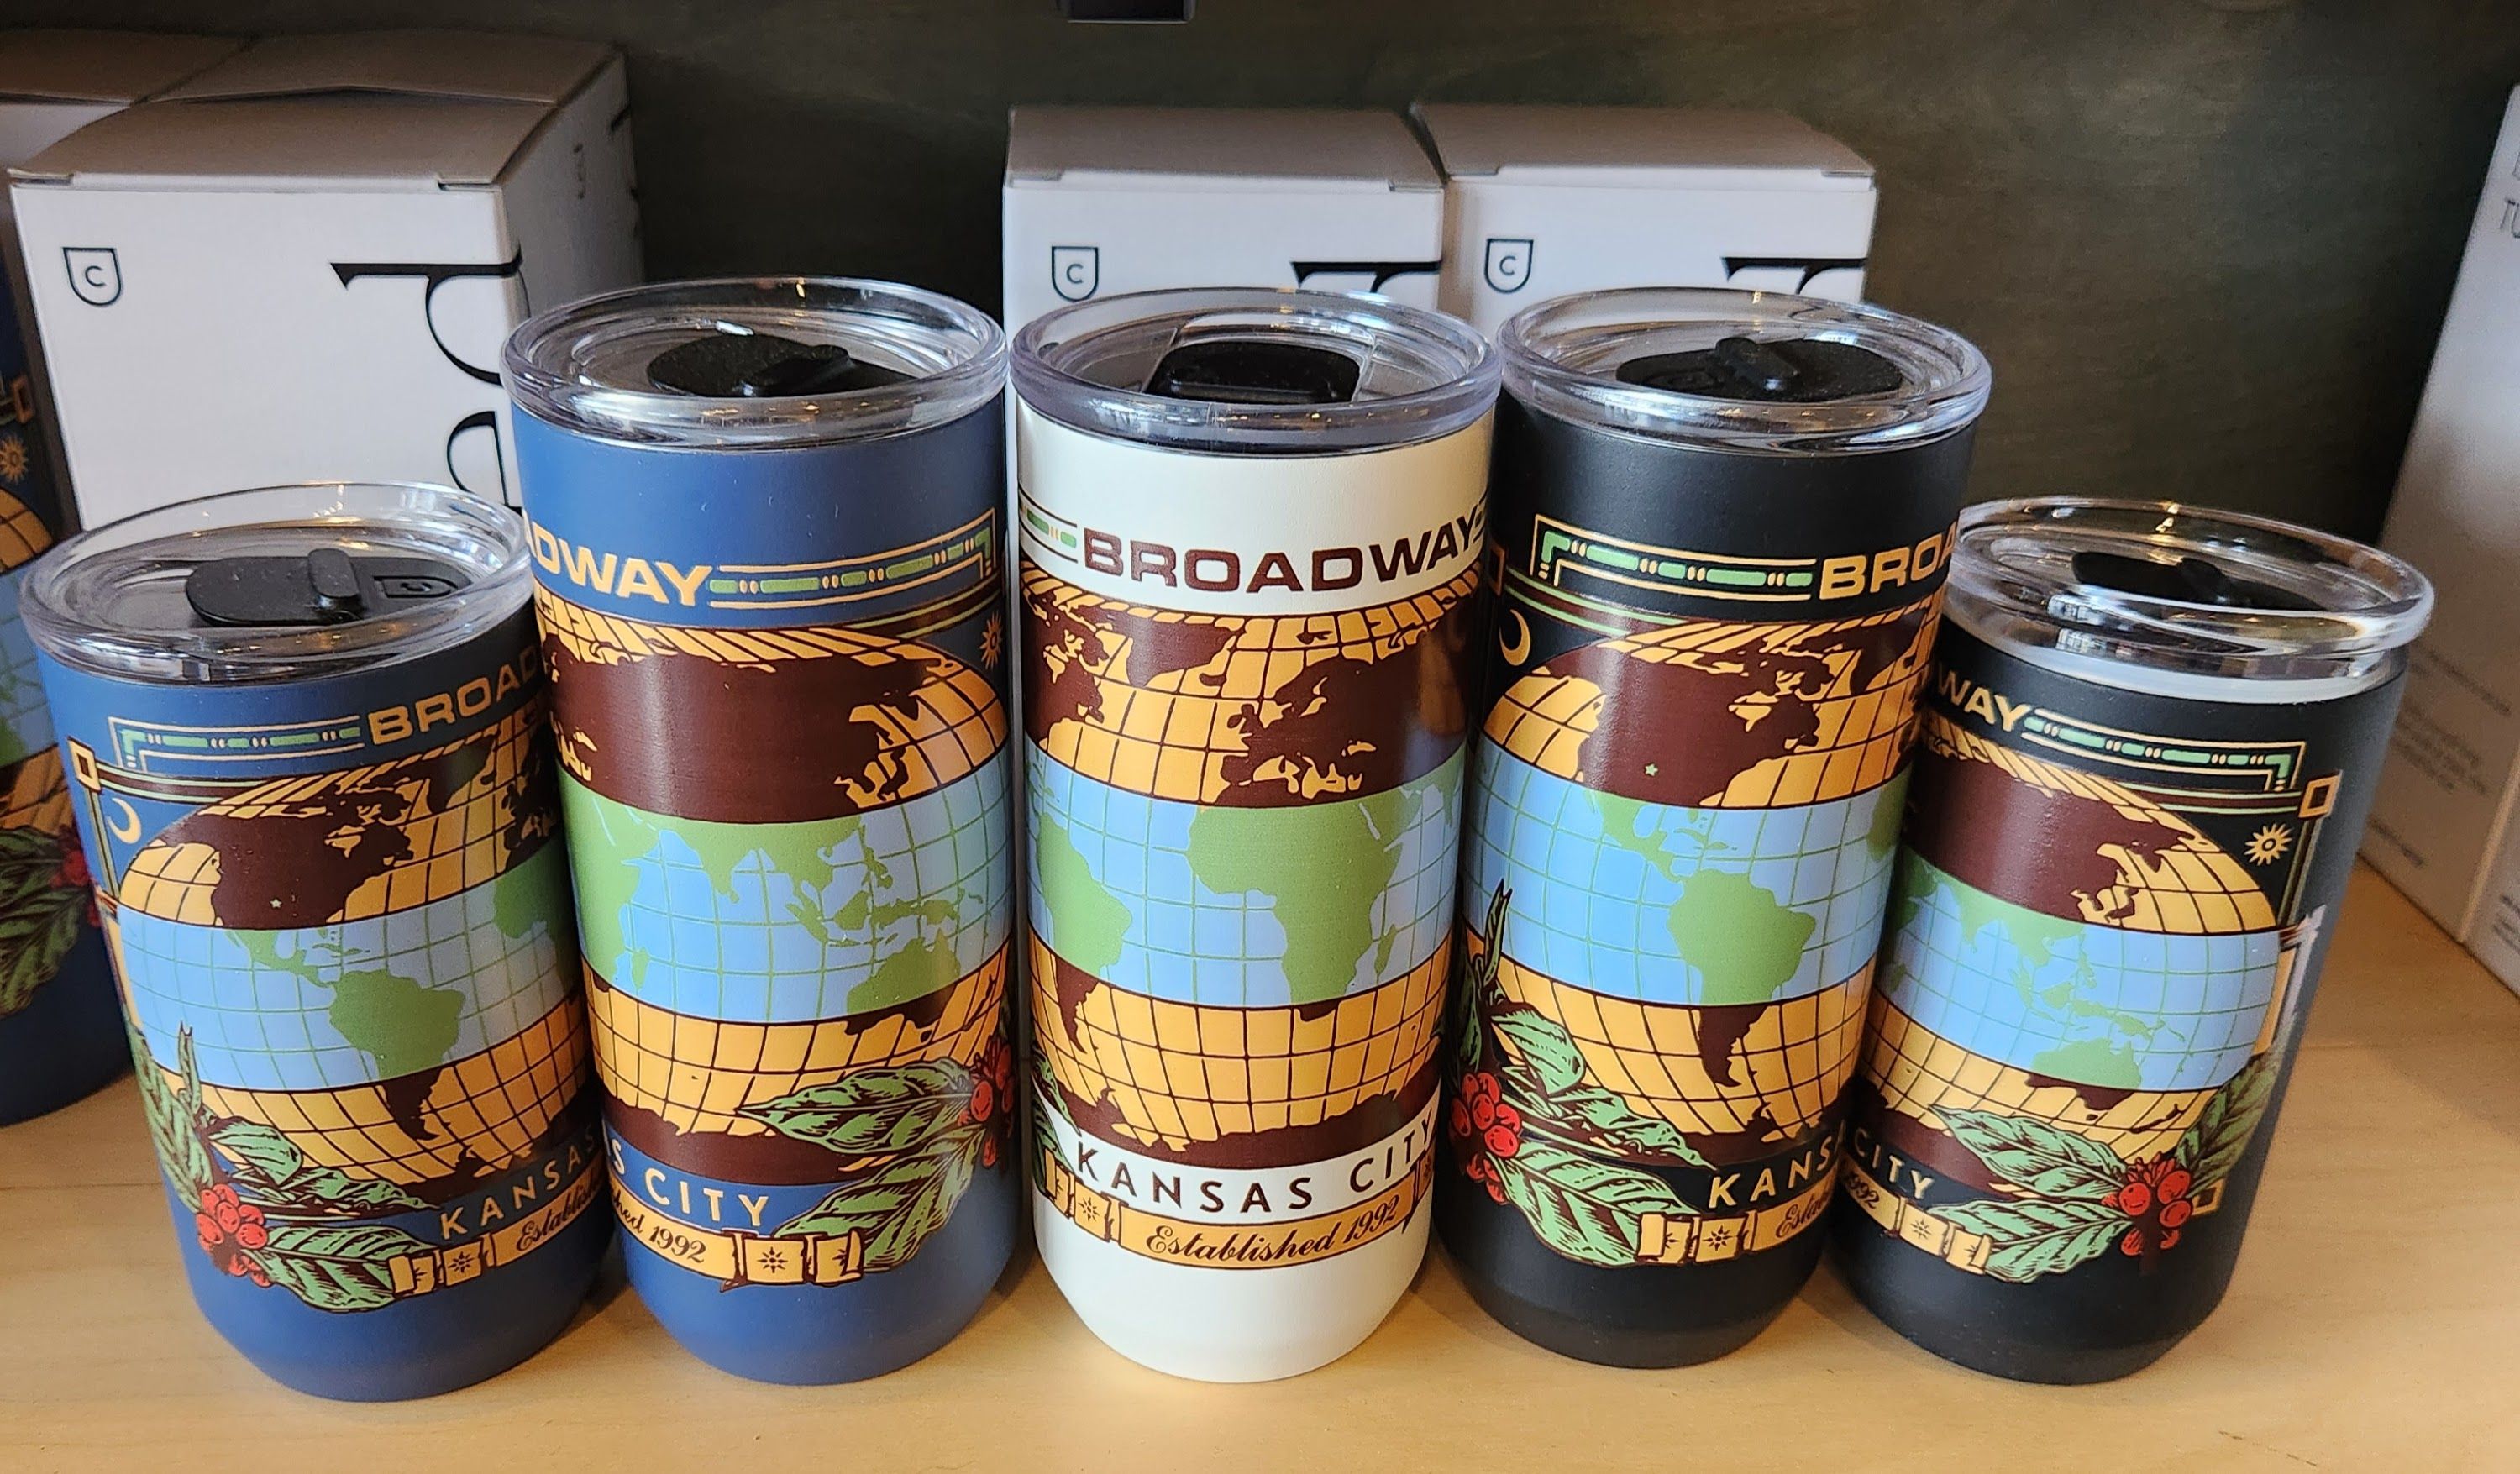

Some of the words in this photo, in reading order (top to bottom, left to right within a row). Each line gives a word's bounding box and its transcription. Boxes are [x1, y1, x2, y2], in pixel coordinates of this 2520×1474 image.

[524, 511, 713, 606] DWAY
[1082, 504, 1478, 594] BROADWAY
[1078, 1141, 1313, 1214] KANSAS
[1349, 1108, 1433, 1193] CITY
[1845, 1172, 1880, 1209] 992
[1853, 1127, 1935, 1200] CITY
[644, 1167, 769, 1227] CITY
[1145, 1220, 1343, 1262] Established
[1342, 1193, 1400, 1244] 1992
[648, 1225, 707, 1264] 1992
